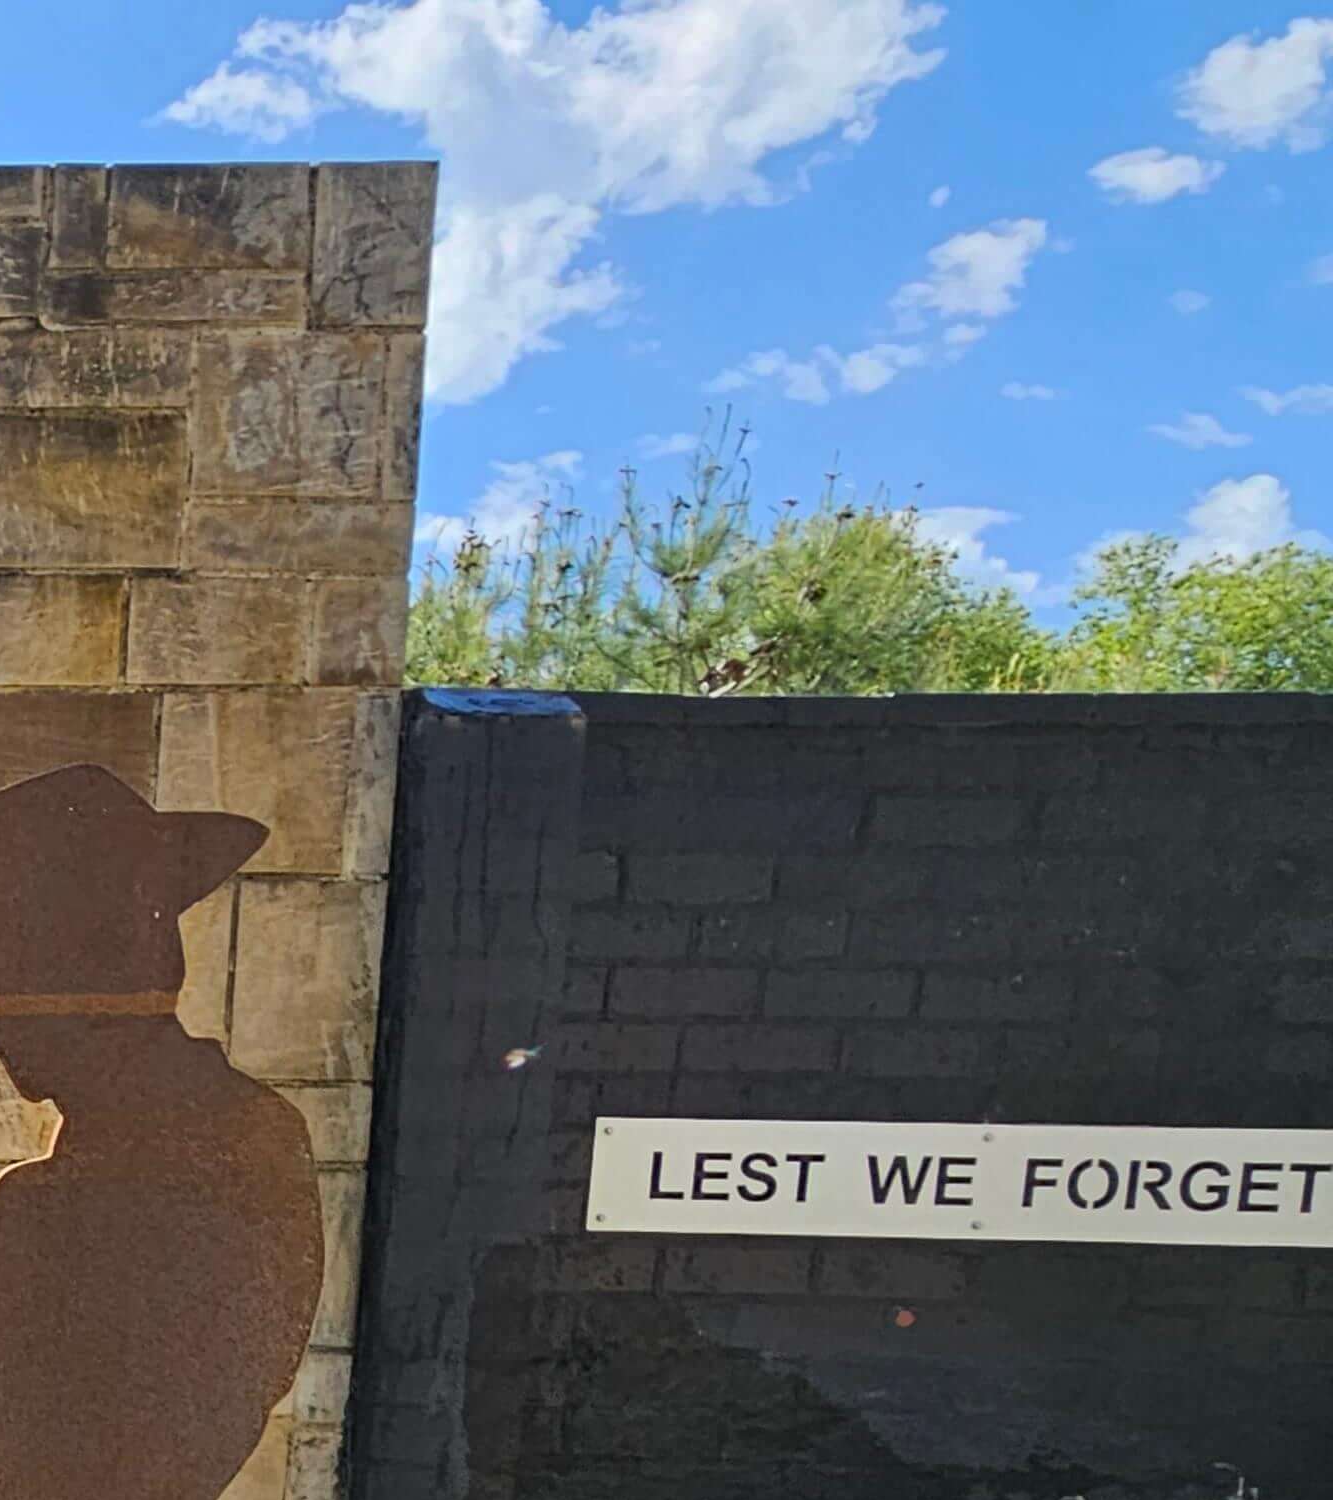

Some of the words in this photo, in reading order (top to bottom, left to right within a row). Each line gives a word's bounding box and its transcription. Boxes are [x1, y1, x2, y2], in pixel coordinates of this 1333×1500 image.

[649, 1151, 826, 1203] LEST
[867, 1154, 978, 1206] WE
[1021, 1157, 1333, 1214] FORGET
